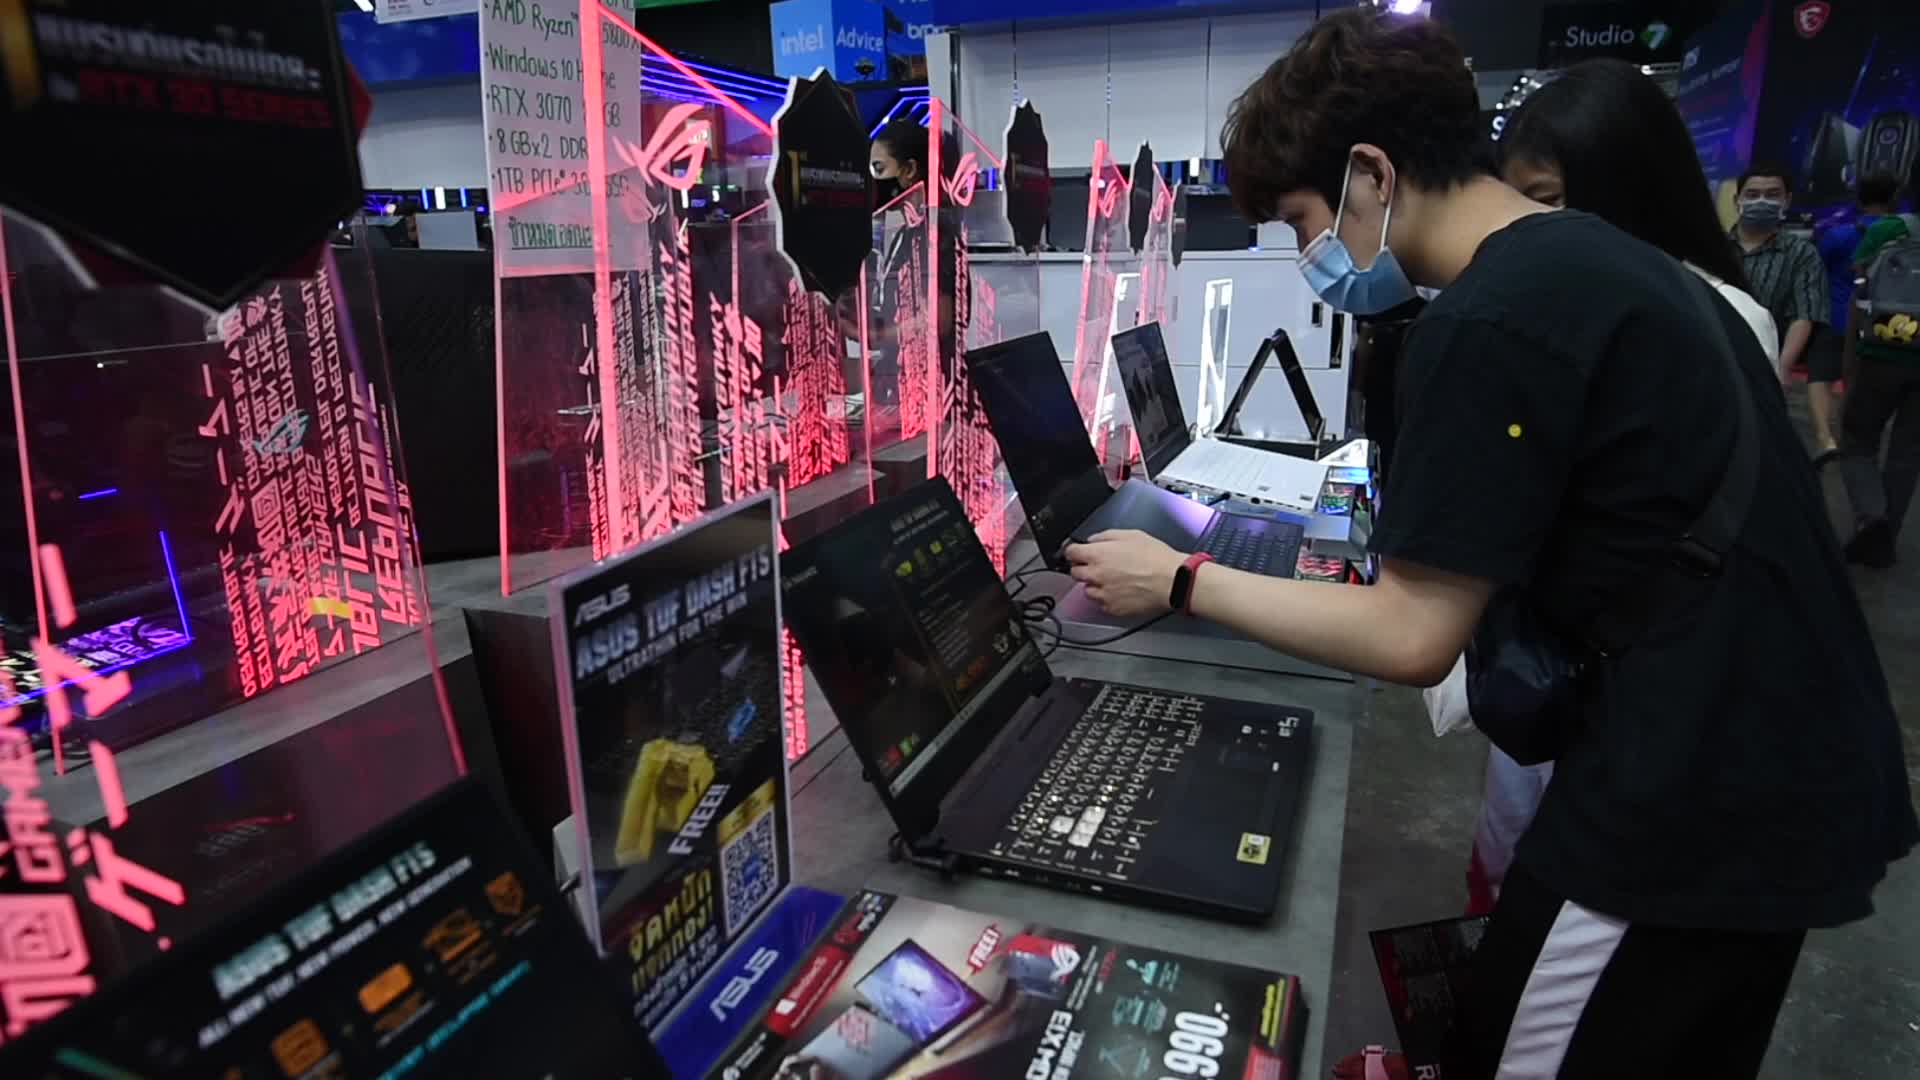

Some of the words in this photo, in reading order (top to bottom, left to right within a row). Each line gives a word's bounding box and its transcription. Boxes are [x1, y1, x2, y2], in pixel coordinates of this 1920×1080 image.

[493, 0, 526, 25] AMD
[781, 24, 824, 57] intel
[836, 26, 884, 52] Advice
[1565, 25, 1635, 49] Studio
[489, 42, 557, 80] Windows
[560, 58, 573, 80] 10
[491, 84, 529, 120] RTX
[536, 92, 572, 124] 3070
[574, 583, 631, 627] ASUS
[577, 611, 640, 680] ASUS
[645, 588, 681, 640] TUF
[709, 946, 779, 1022] ASUS
